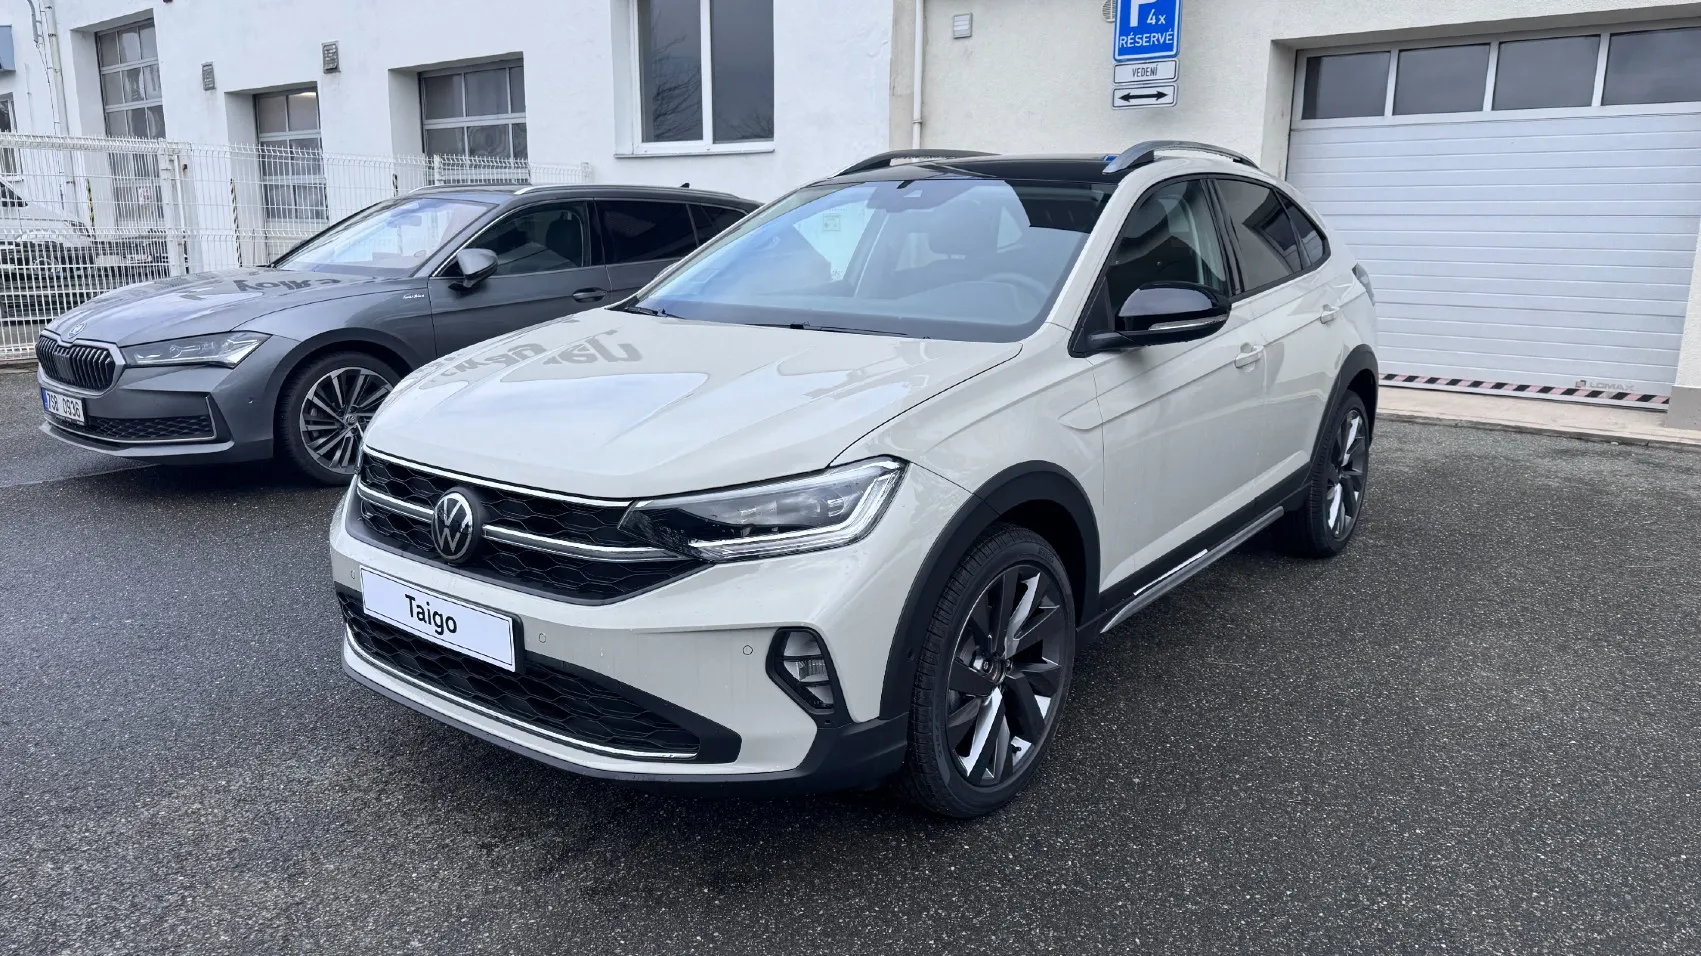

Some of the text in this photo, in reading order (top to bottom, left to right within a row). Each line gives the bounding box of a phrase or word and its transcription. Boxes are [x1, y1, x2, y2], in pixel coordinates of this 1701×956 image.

[1119, 28, 1174, 48] RÉSERVÉ
[1132, 64, 1159, 77] VEDENÍ
[1589, 381, 1634, 392] LOMAX
[404, 594, 457, 635] Taigo
